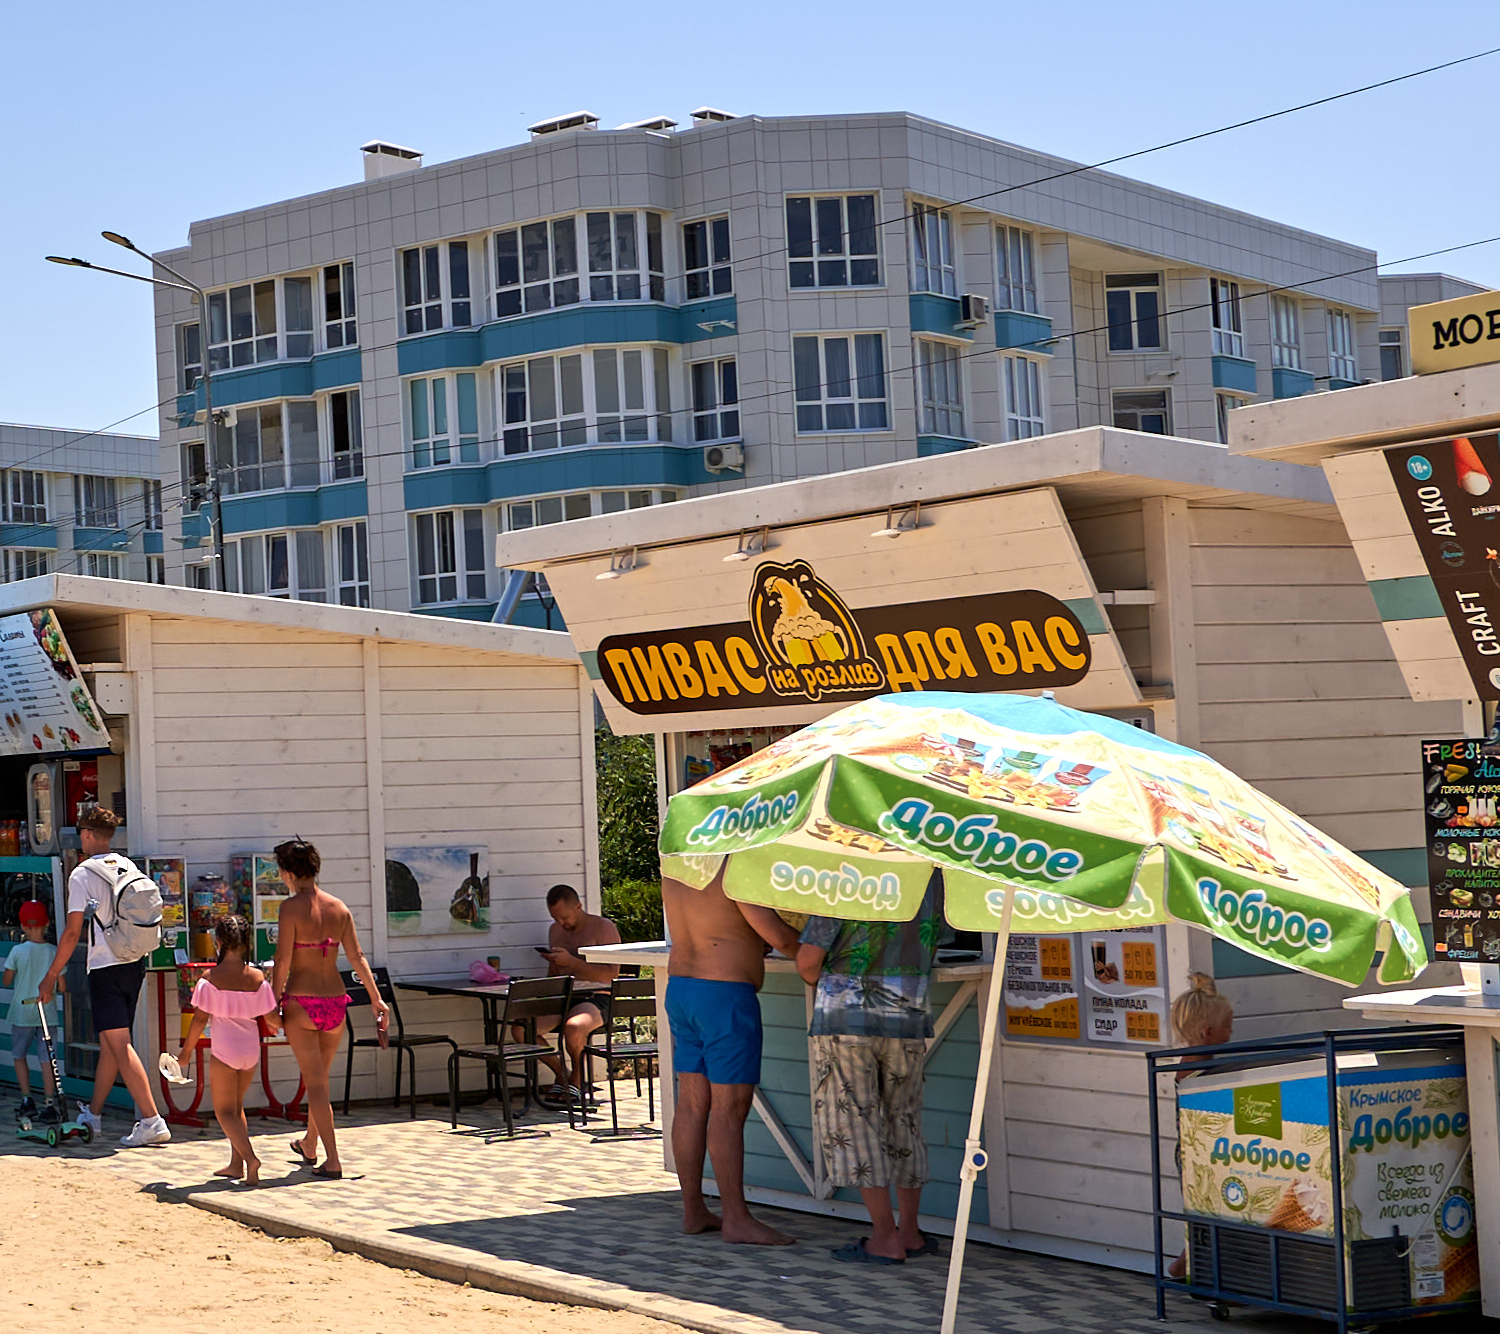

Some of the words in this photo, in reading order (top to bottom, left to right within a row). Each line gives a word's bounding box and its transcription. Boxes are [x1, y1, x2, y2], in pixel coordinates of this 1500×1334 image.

[1418, 485, 1457, 537] ALKO
[603, 636, 767, 705] ПИВАС
[872, 627, 969, 691] ДЛЯ
[977, 615, 1087, 675] ВАС
[772, 668, 800, 688] на
[803, 665, 879, 695] розлив
[1440, 784, 1476, 795] ГОРЯЧАЯ
[686, 789, 799, 846] Доброе
[1434, 827, 1482, 838] МОЛОЧНЫЕ
[879, 796, 1085, 882] Доброе
[1196, 876, 1333, 953] Доброе
[1349, 1088, 1422, 1109] Крымское
[1349, 1105, 1468, 1154] Доброе
[1210, 1137, 1312, 1172] Доброе
[1377, 1162, 1426, 1185] Всегда
[1428, 1161, 1444, 1183] из
[1377, 1186, 1432, 1203] свежего
[1379, 1203, 1431, 1219] молока
